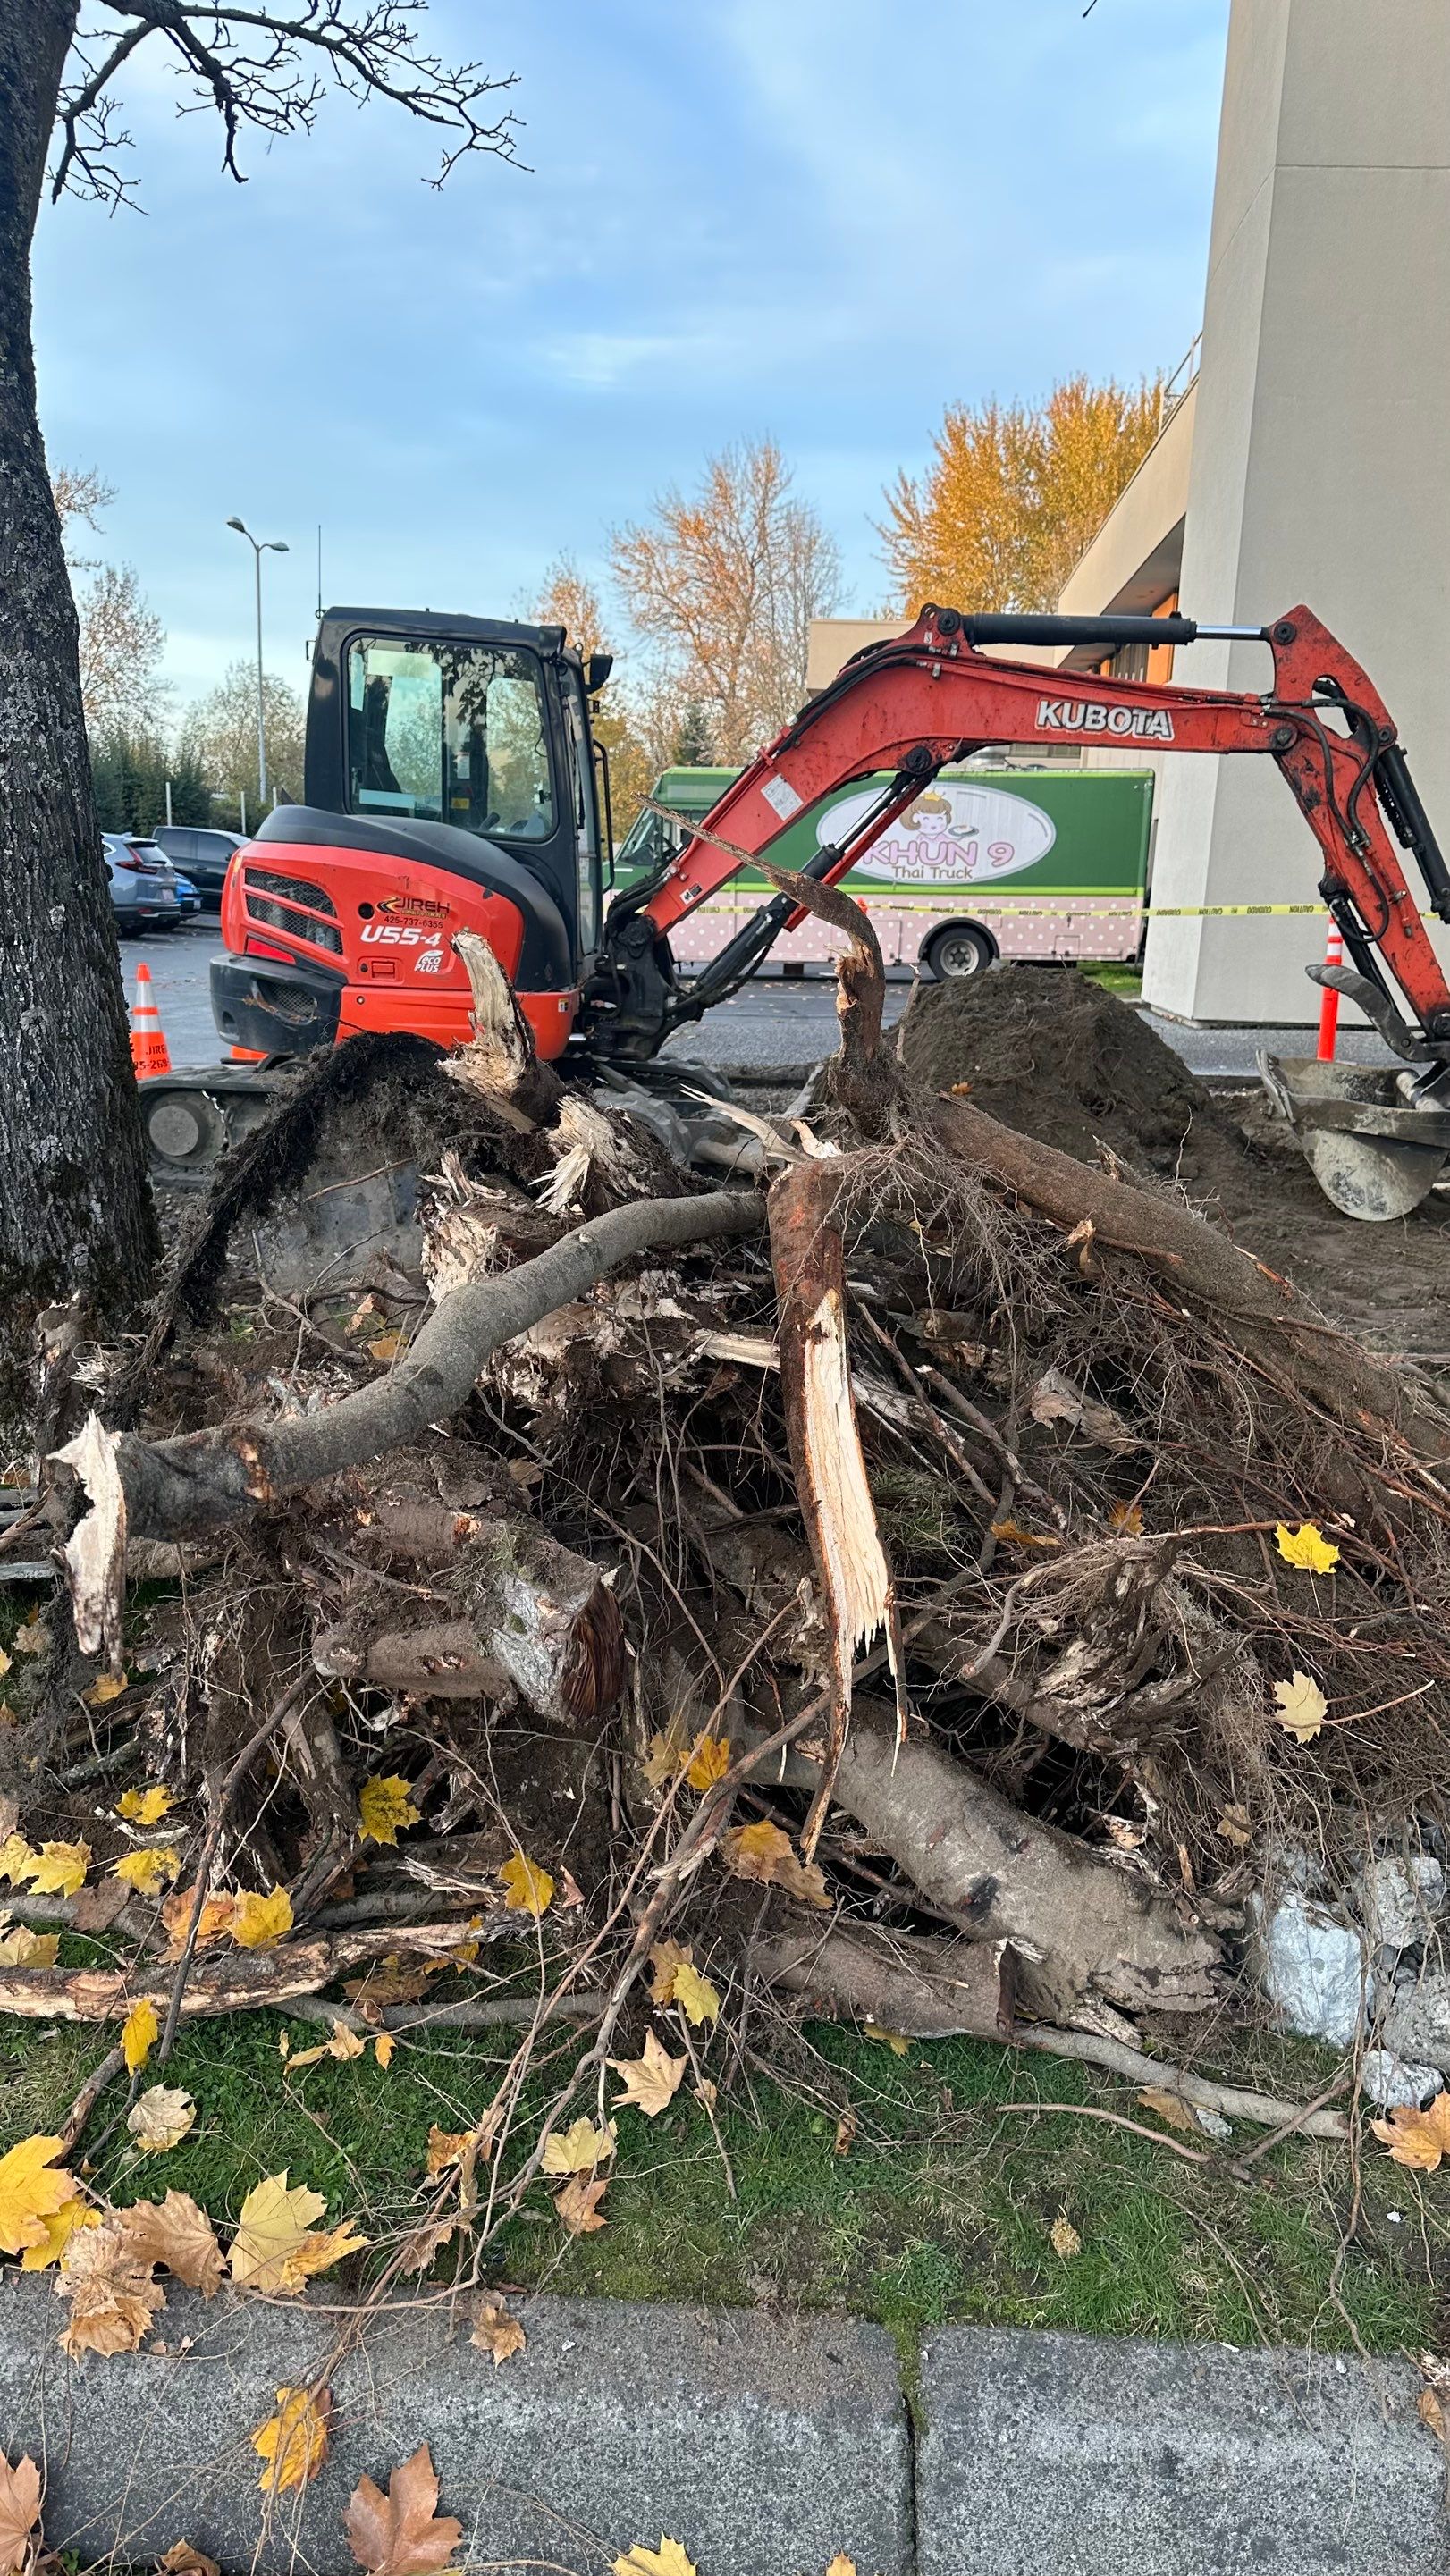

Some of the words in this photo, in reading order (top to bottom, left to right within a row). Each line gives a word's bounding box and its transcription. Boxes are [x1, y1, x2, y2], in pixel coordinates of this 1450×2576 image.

[1036, 699, 1173, 739] KUBOTA
[863, 840, 978, 866] KHUN
[987, 841, 1015, 868] 9
[892, 865, 924, 879] Thai
[930, 866, 973, 879] Truck
[394, 897, 450, 913] JIREH
[1289, 905, 1314, 913] CAUTION
[384, 915, 444, 929] 425-737-6355
[360, 924, 442, 947] U55-4
[422, 956, 441, 964] eco
[414, 964, 439, 972] PLUS
[146, 1044, 167, 1056] JIRE
